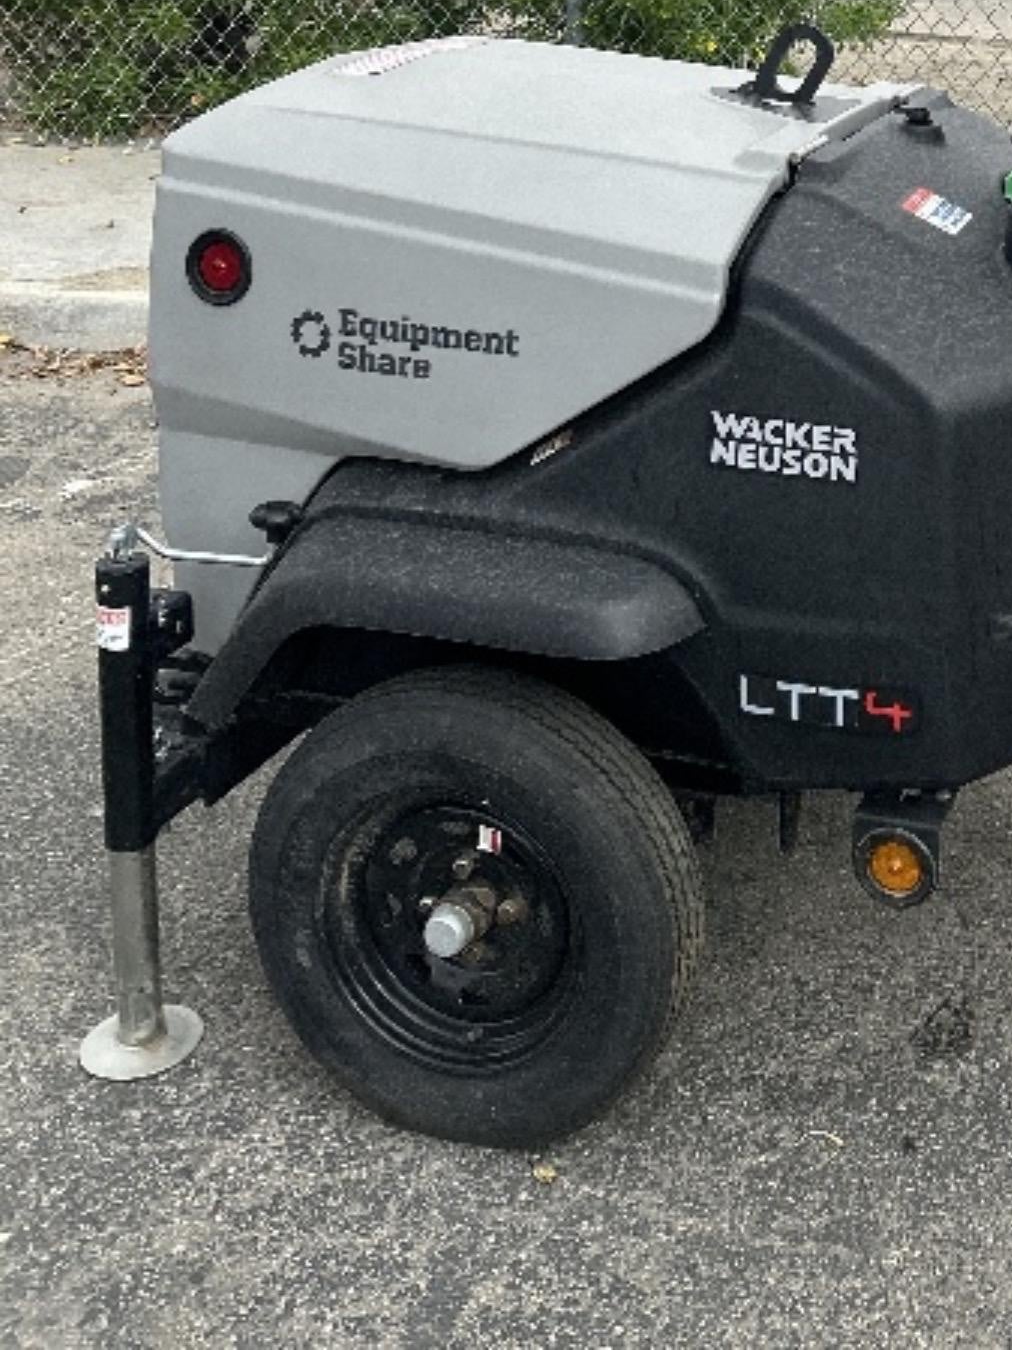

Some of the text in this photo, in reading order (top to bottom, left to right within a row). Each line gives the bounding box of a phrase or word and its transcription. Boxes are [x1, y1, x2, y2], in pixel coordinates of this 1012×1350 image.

[338, 308, 520, 357] Equipment
[337, 341, 432, 379] Share
[710, 410, 857, 454] WACKER
[710, 437, 858, 483] NEUSON
[739, 673, 912, 733] LTT4
